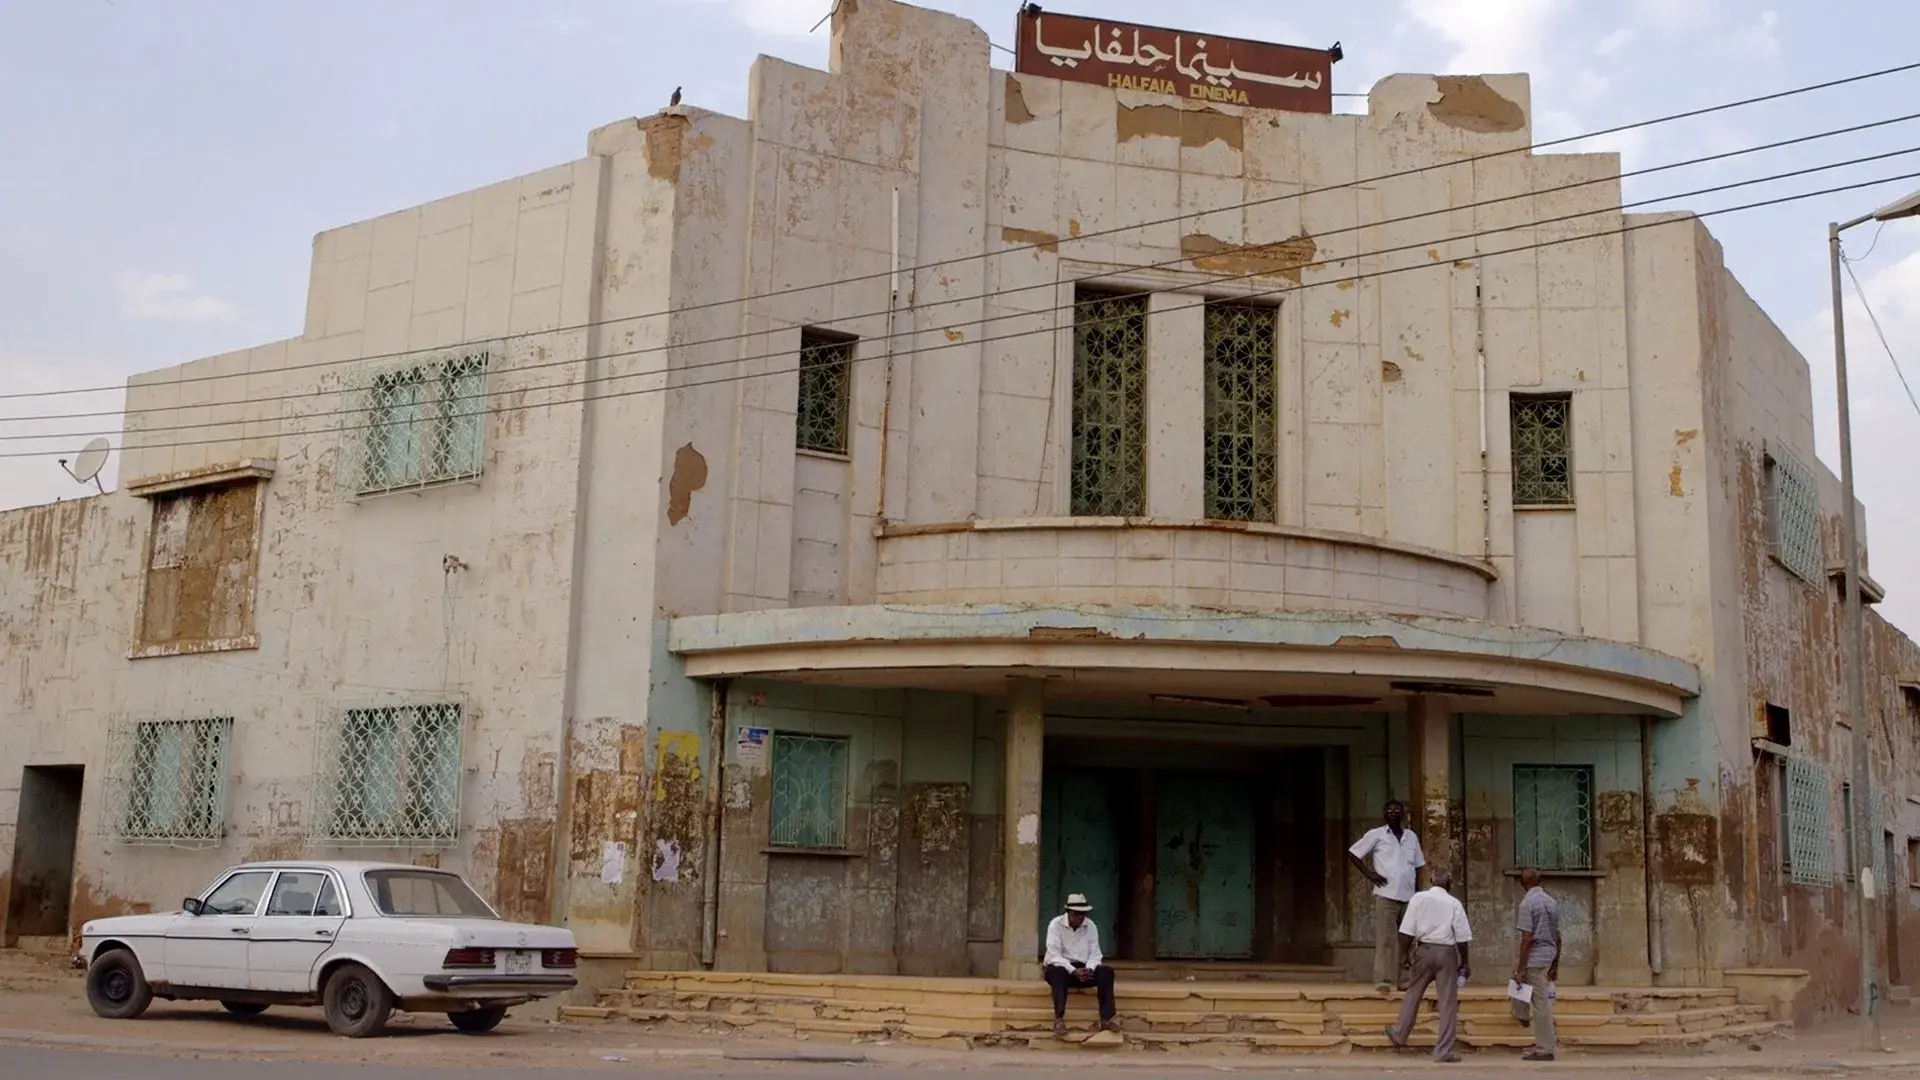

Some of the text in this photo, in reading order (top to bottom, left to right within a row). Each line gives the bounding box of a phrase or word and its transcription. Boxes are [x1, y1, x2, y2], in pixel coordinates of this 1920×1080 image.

[1035, 16, 1322, 90] سينما حلفايا
[1107, 73, 1249, 105] HALFAIA CINEMA
